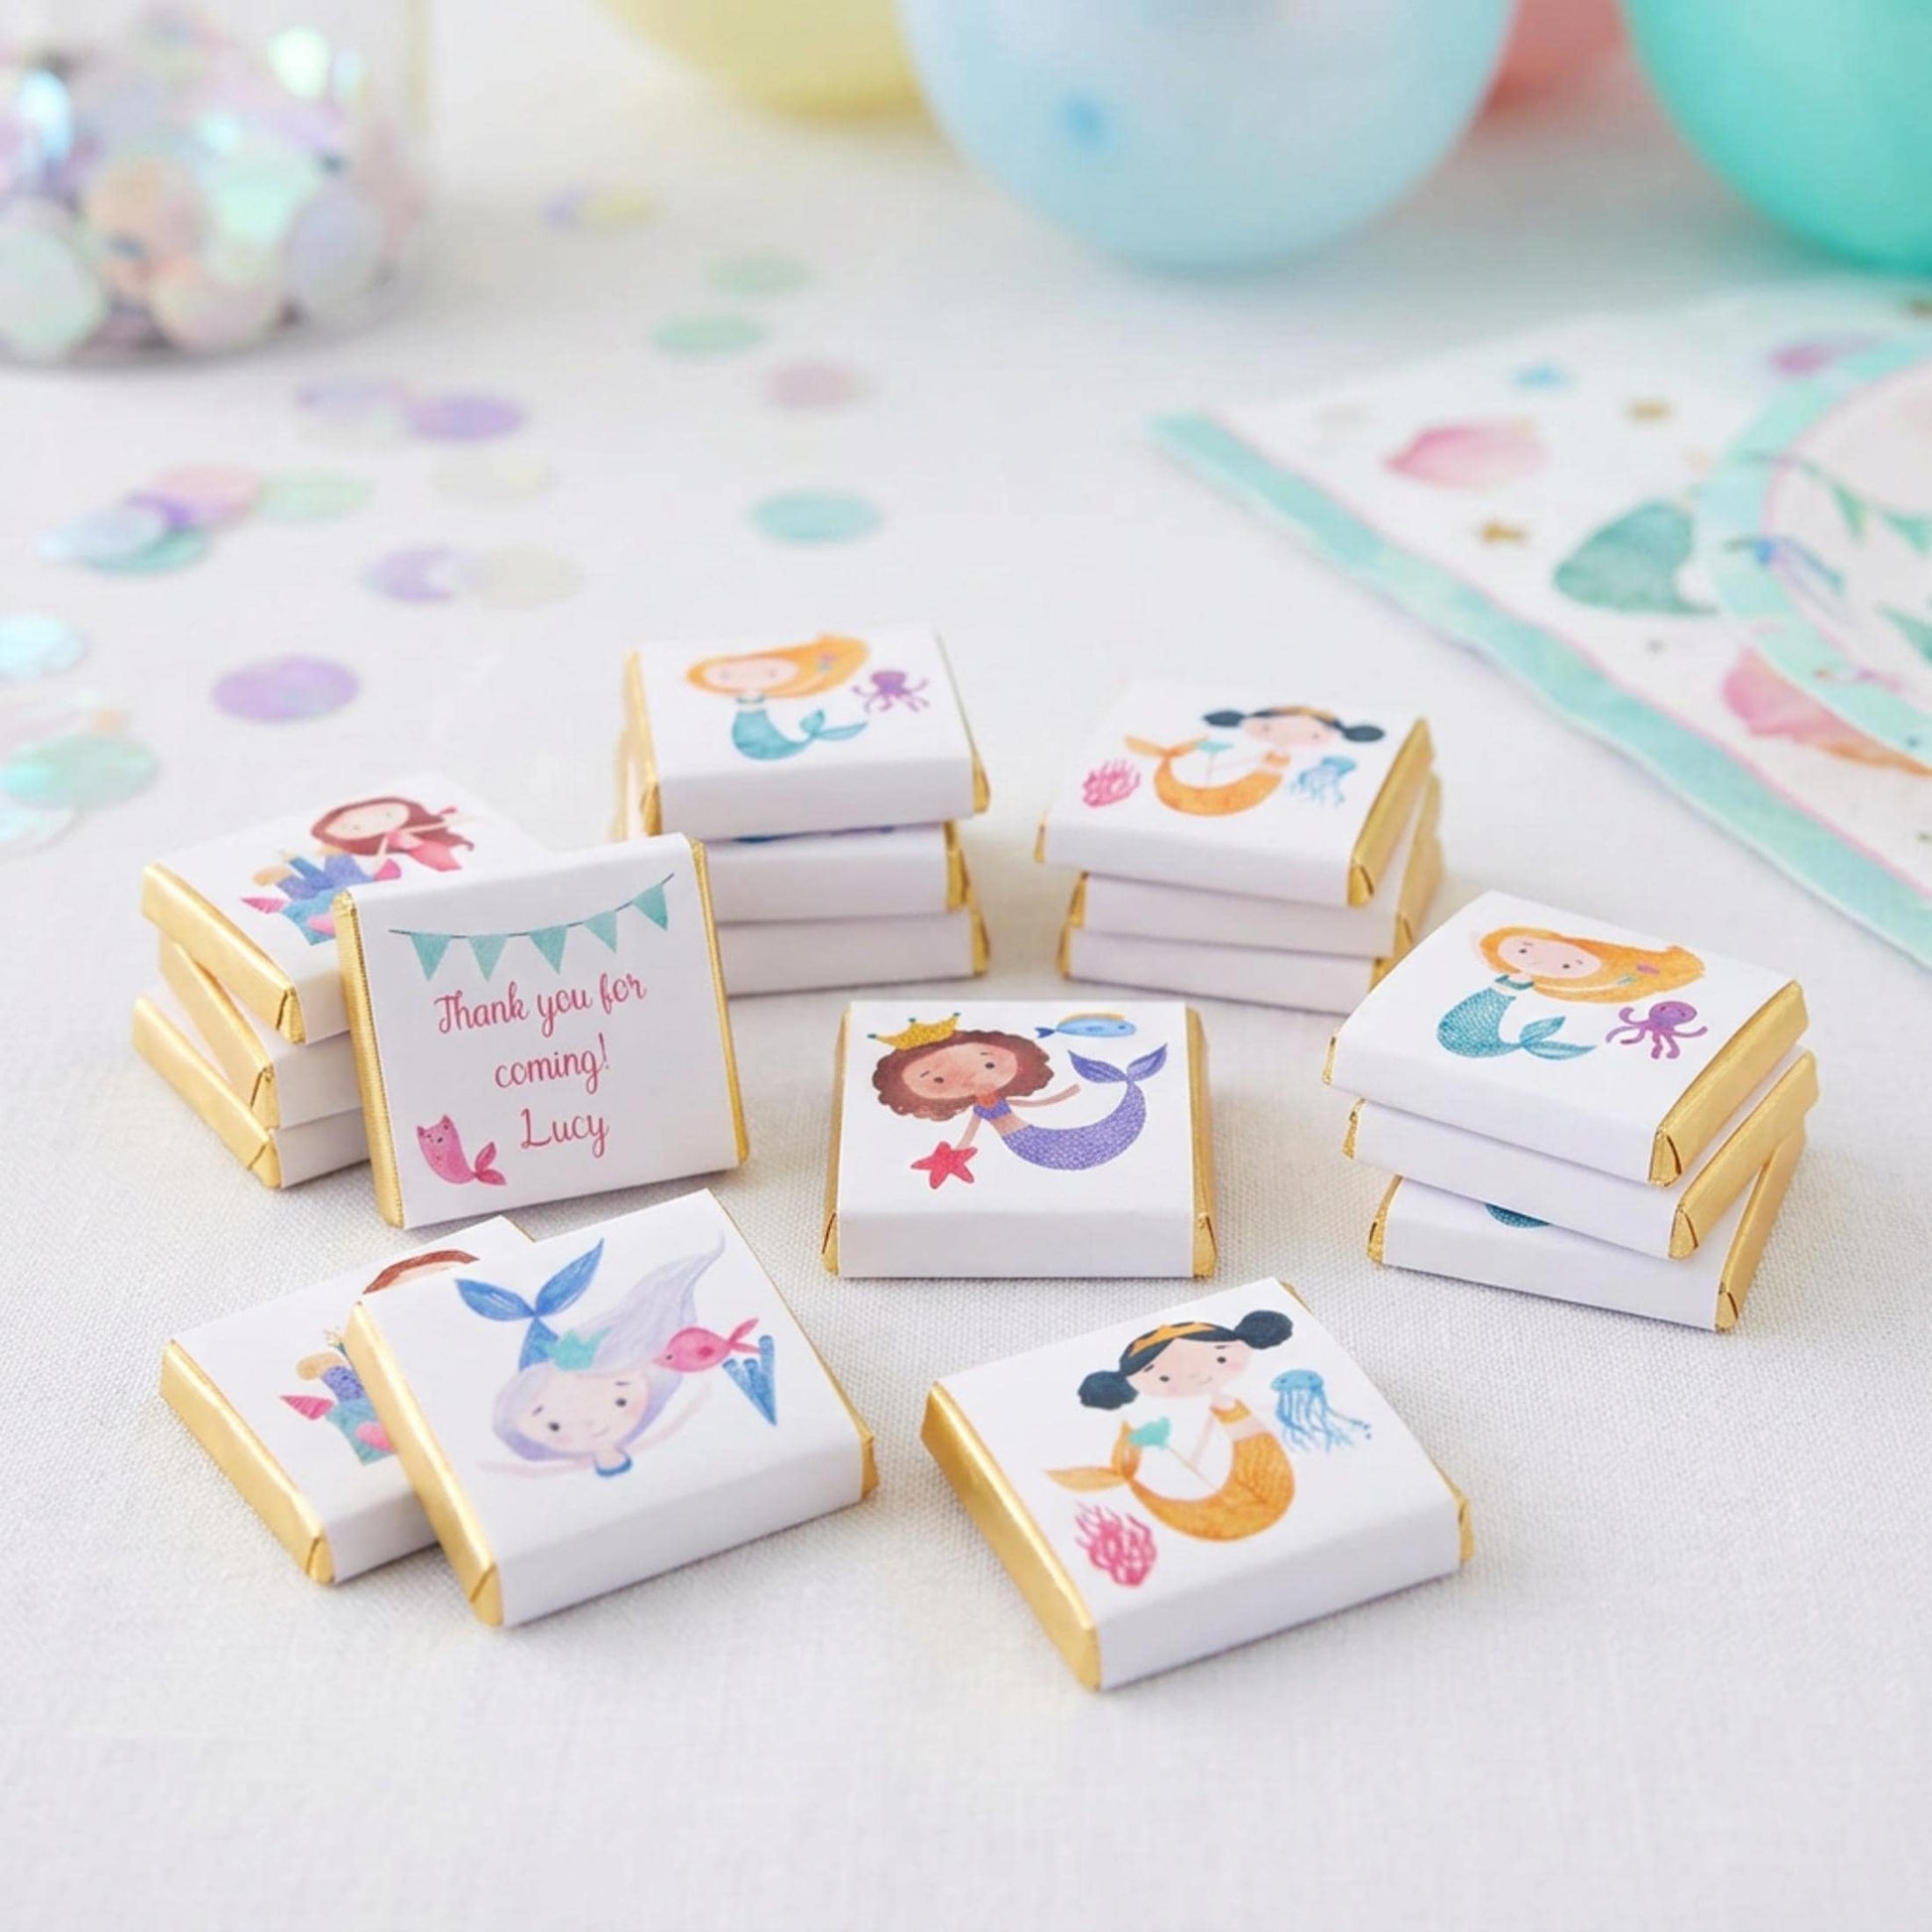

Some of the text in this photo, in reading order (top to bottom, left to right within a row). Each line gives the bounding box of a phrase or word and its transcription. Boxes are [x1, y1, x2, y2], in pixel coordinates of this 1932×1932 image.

[434, 972, 647, 1037] Thank you for
[494, 1032, 610, 1094] coming!
[519, 1108, 610, 1159] Lucy
